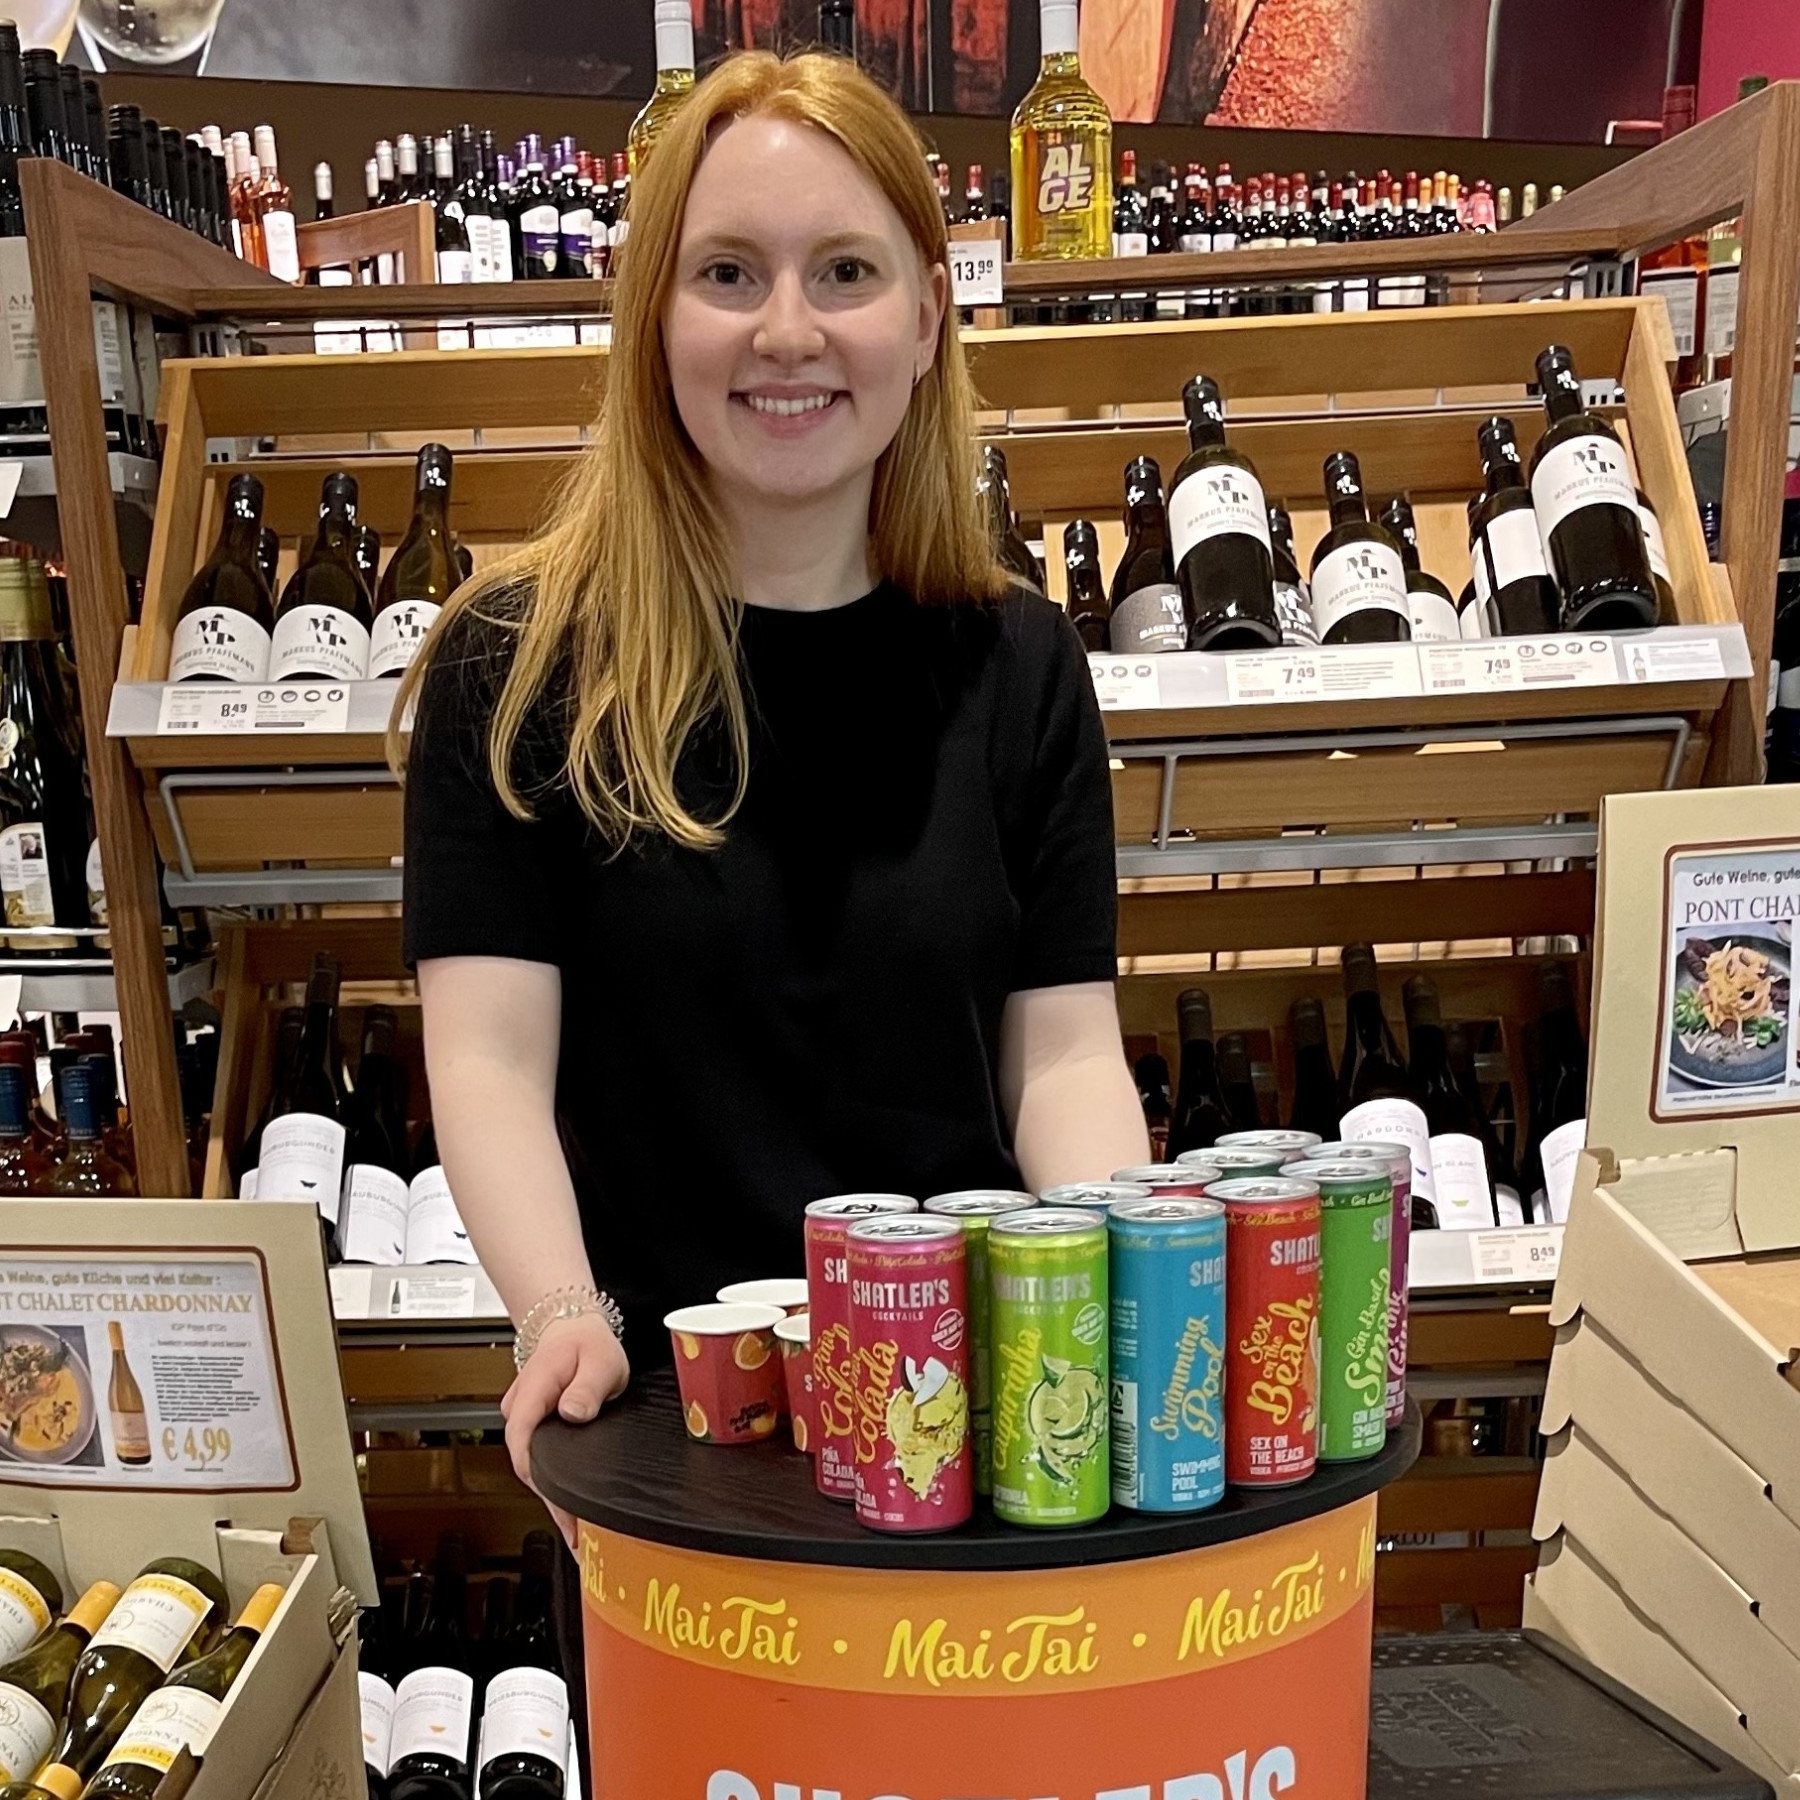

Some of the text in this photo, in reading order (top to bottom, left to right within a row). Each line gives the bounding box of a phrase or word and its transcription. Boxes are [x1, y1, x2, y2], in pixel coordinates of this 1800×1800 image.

[953, 260, 993, 281] 13.99
[1693, 873, 1724, 886] Gute
[1728, 868, 1770, 884] Weine,
[1685, 897, 1745, 924] PONT
[126, 1273, 150, 1285] und
[824, 1258, 848, 1284] SH
[17, 1292, 94, 1311] CHALET
[96, 1292, 252, 1313] CHARDONNAY
[852, 1279, 950, 1309] SHATLER'S
[1239, 1314, 1273, 1364] Sex
[1246, 1292, 1315, 1426] Beach
[1150, 1314, 1210, 1441] Swimming
[1182, 1336, 1225, 1439] Pool
[162, 1427, 232, 1470] € 4,99
[1250, 1434, 1289, 1450] SEX ON
[1250, 1445, 1305, 1465] THE BEACH
[1172, 1475, 1199, 1492] POOL
[581, 1530, 607, 1603] Tai
[1355, 1515, 1376, 1590] M
[643, 1577, 802, 1666] Mai Tai
[1176, 1550, 1326, 1661] Mai Tai
[882, 1605, 1101, 1688] Mai Tai
